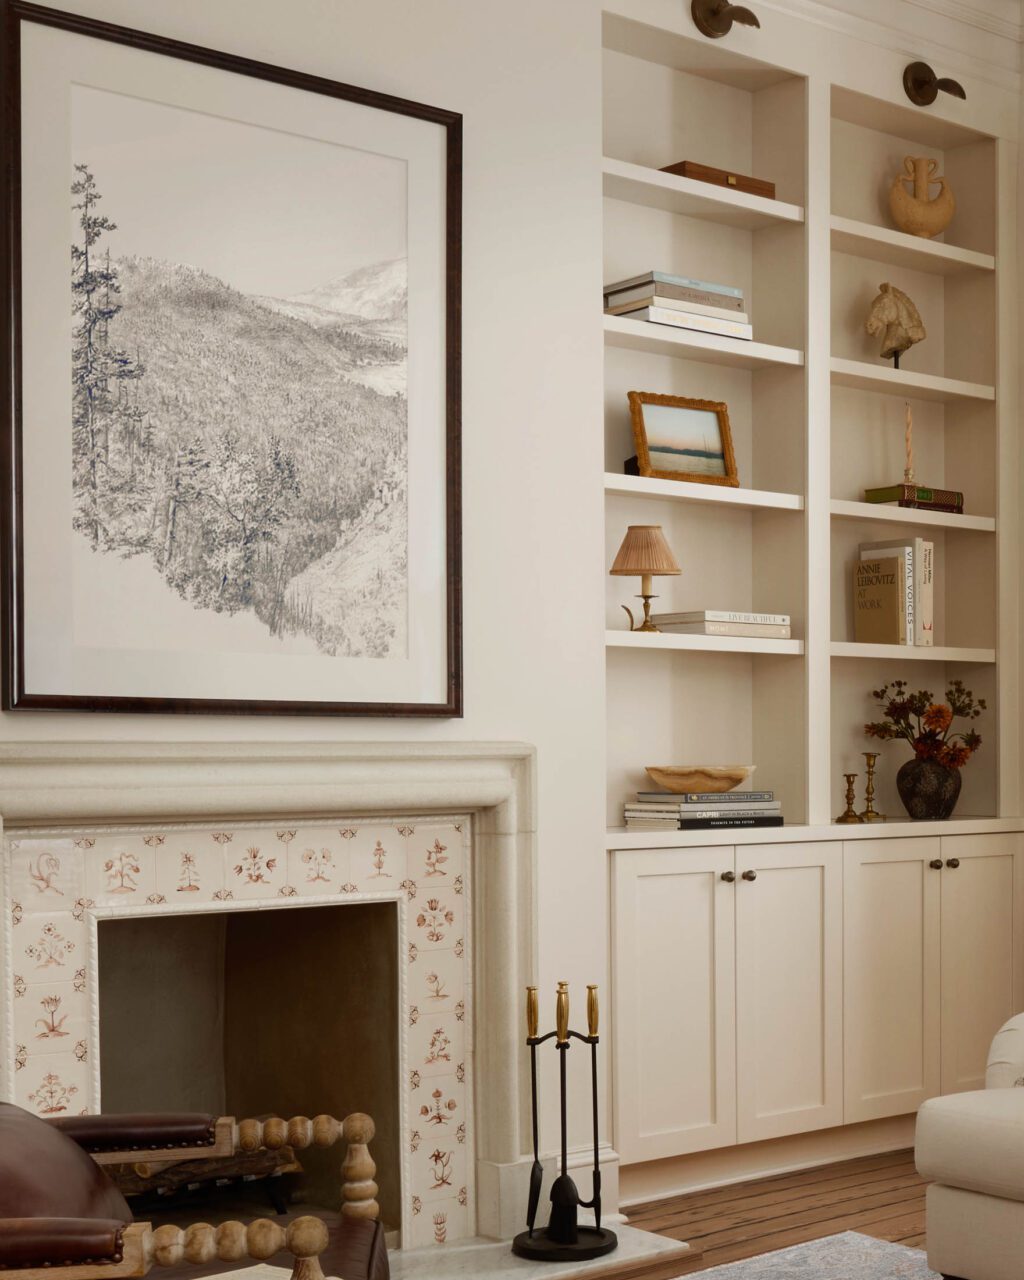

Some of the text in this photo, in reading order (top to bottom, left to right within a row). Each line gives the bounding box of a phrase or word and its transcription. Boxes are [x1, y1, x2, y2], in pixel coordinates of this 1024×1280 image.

[857, 564, 880, 575] ANNIE
[858, 574, 896, 586] LEIBOVITZ
[858, 589, 866, 598] AT
[858, 600, 882, 610] WORK
